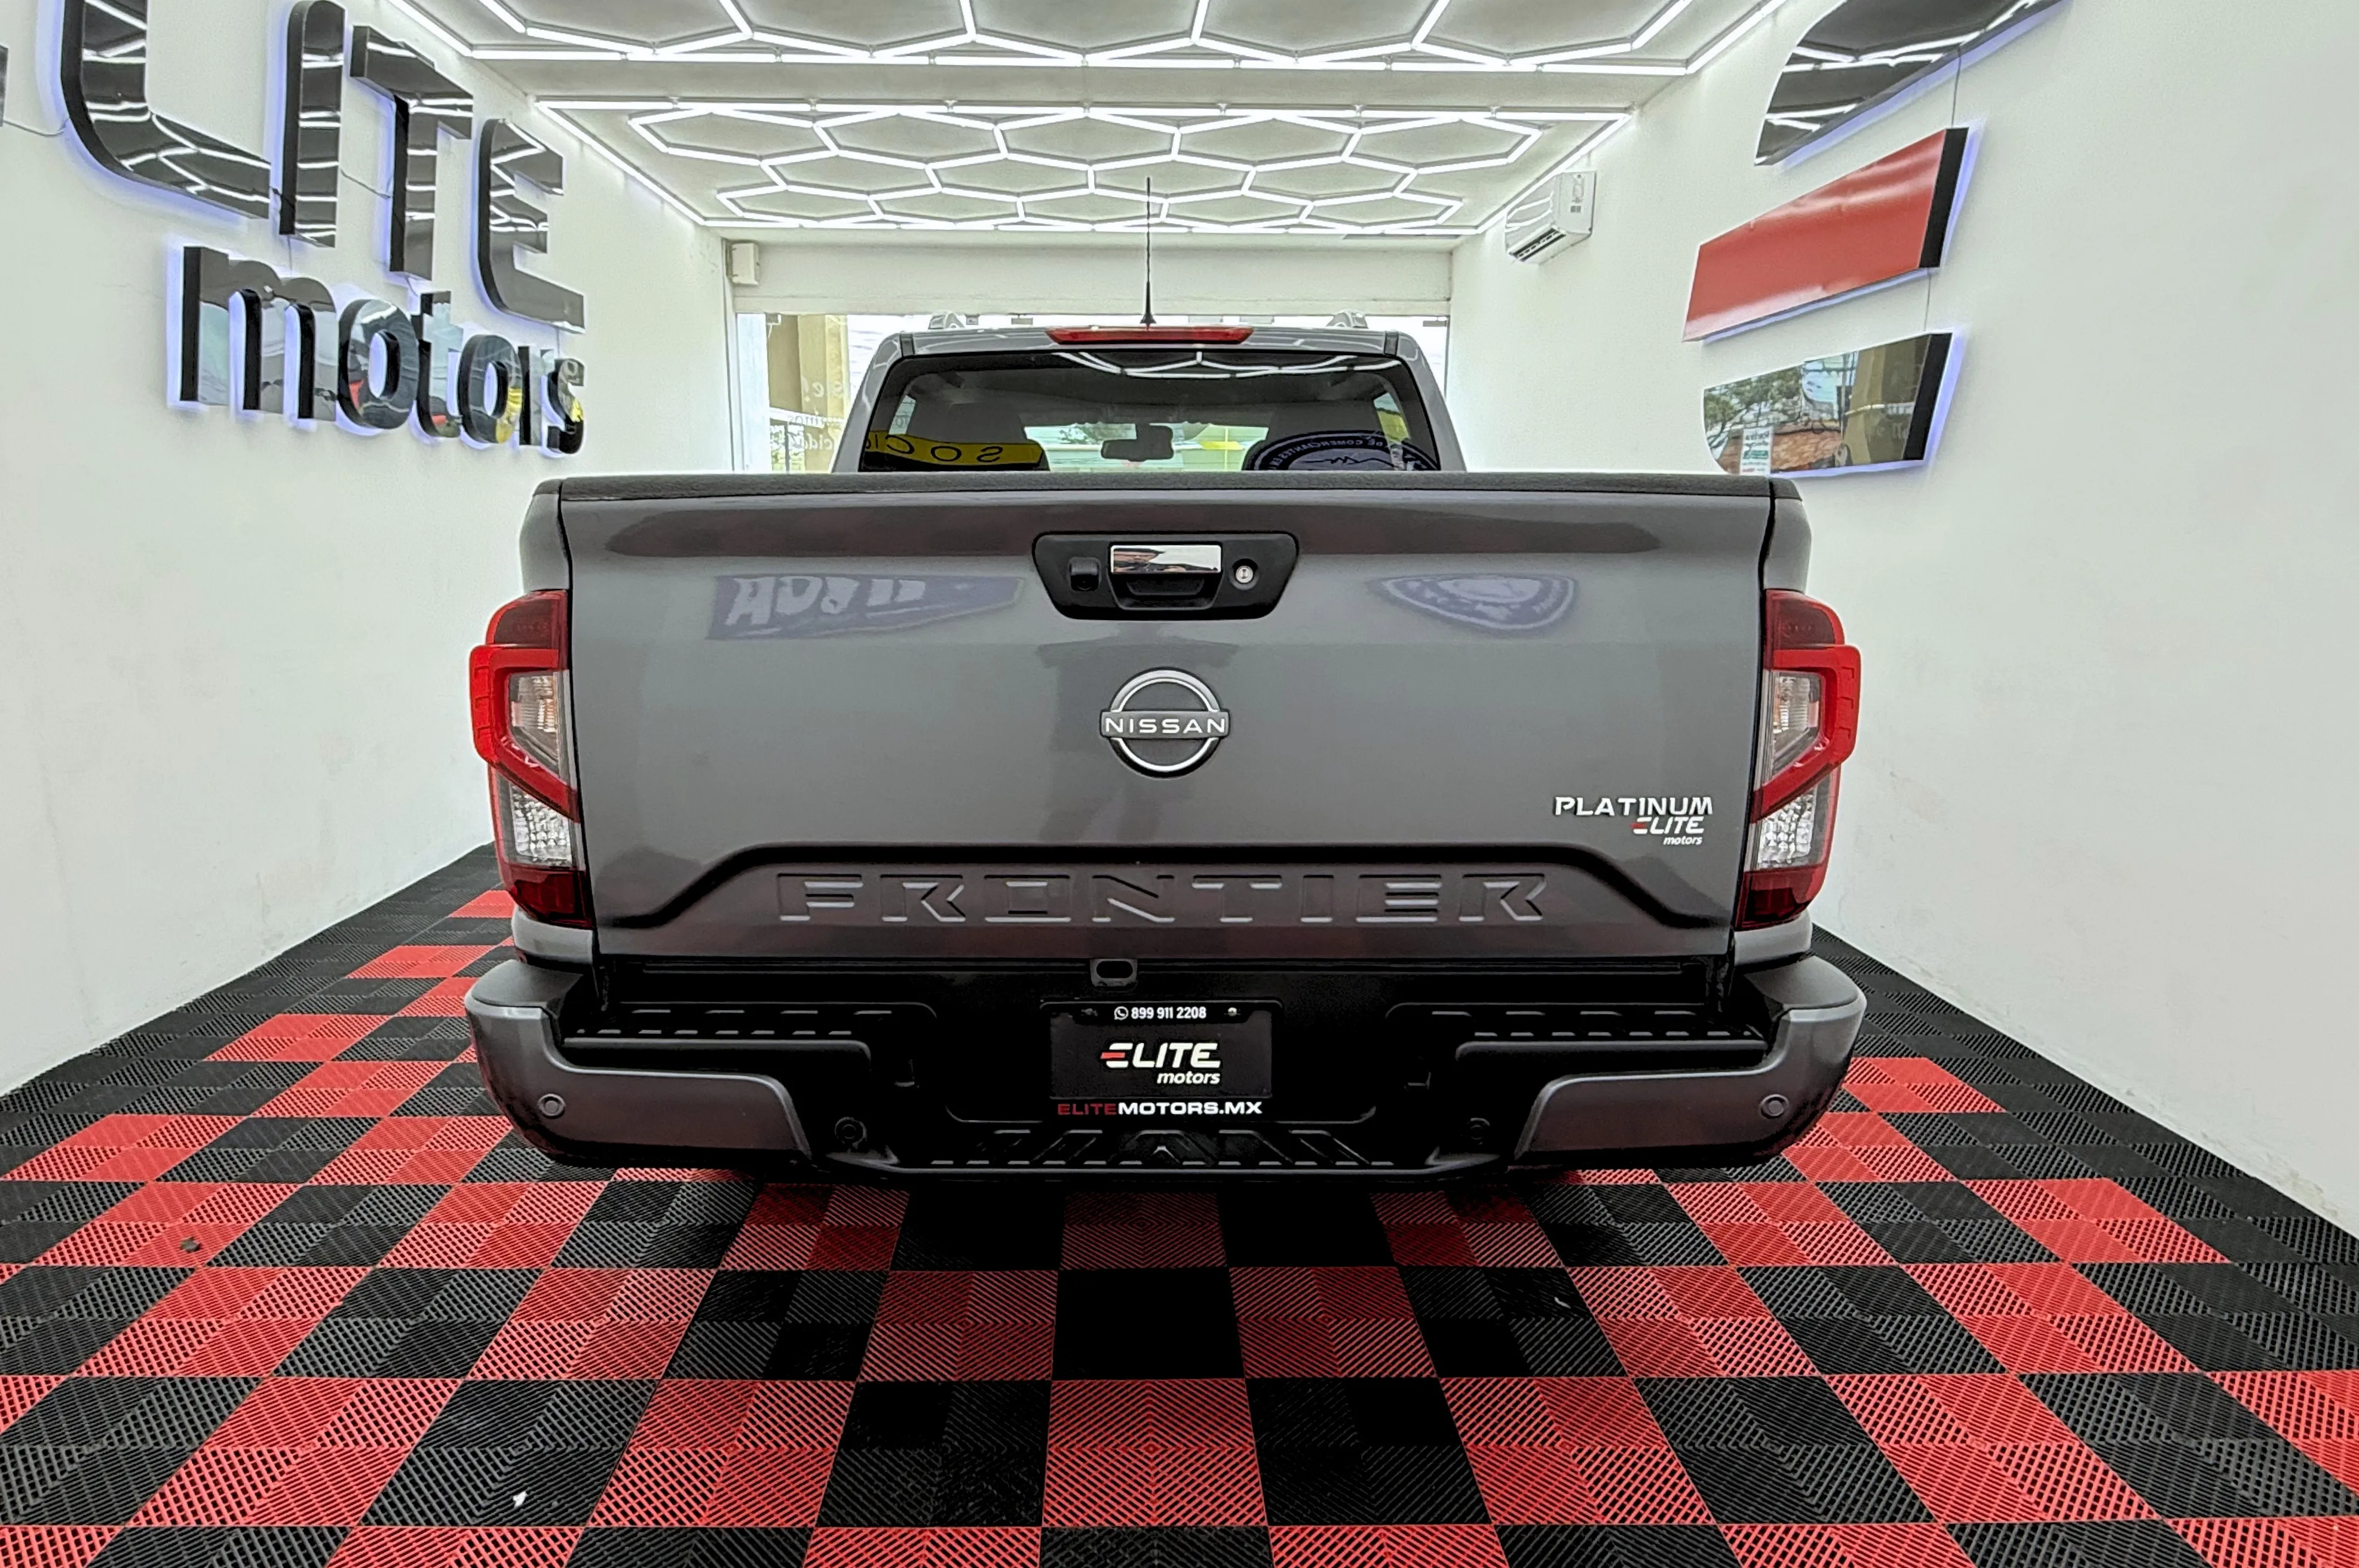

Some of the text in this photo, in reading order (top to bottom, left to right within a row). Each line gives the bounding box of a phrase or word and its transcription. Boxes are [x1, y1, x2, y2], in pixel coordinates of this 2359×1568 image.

[0, 0, 586, 334] LITE
[179, 246, 586, 455] motors
[1105, 718, 1226, 734] NISSAN
[1555, 796, 1713, 816] PLATINUM
[1630, 816, 1704, 834] ELITE
[1663, 836, 1703, 845] motors
[777, 873, 1546, 923] FRONTIER
[1131, 1007, 1207, 1020] 899 911 2208
[1101, 1042, 1221, 1069] ELITE
[1157, 1071, 1221, 1085] motors
[1058, 1101, 1263, 1116] ELITEMOTORS.MX
